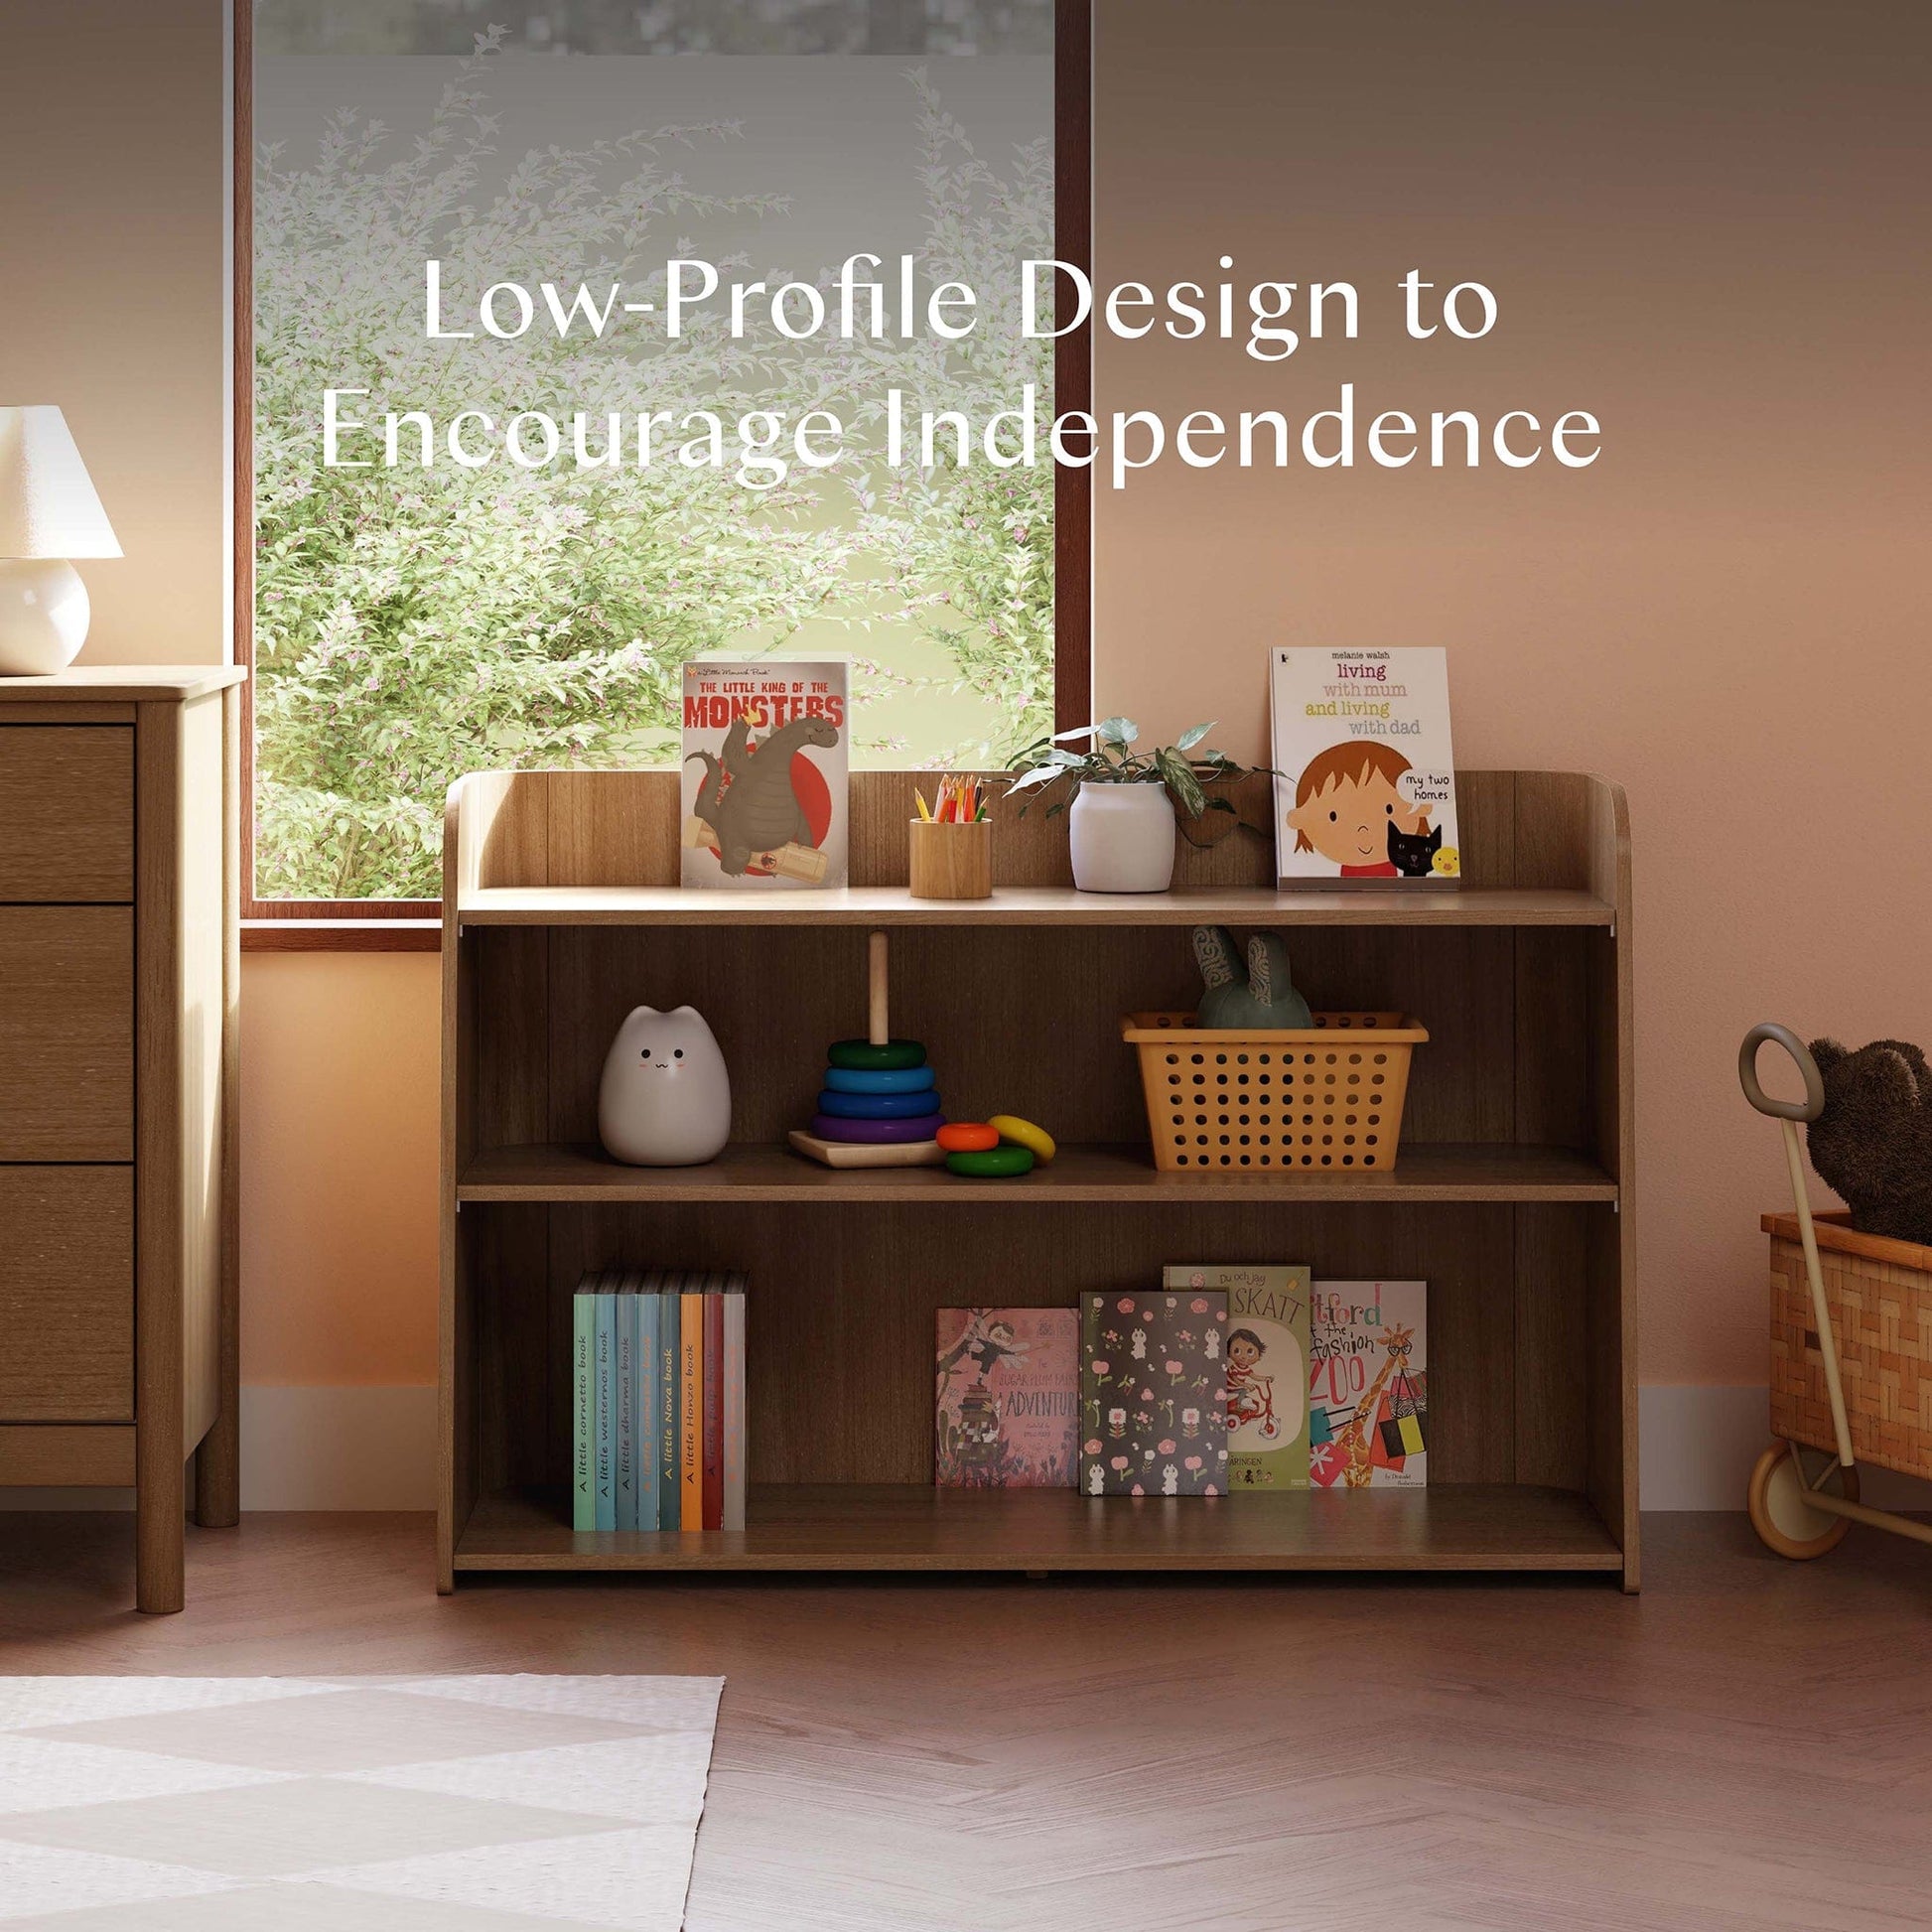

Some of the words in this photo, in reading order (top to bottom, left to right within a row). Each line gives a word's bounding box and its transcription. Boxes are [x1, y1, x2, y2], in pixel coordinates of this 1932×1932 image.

[1331, 651, 1364, 660] melanie
[1366, 651, 1390, 660] walsh
[1337, 663, 1387, 681] living
[700, 682, 717, 693] THE
[723, 682, 755, 693] LITTLE
[761, 682, 786, 693] KING
[792, 682, 804, 693] OF
[811, 682, 828, 693] THE
[1323, 682, 1360, 697] with
[1362, 685, 1408, 697] mum
[684, 695, 844, 729] MONSTERS
[1305, 701, 1337, 716] and
[1341, 700, 1390, 718] living
[1349, 720, 1388, 735] with
[1390, 720, 1421, 735] dad
[1406, 775, 1424, 789] my
[1428, 774, 1449, 785] two
[1414, 789, 1449, 801] homes
[1219, 1274, 1231, 1284] Du
[1234, 1271, 1249, 1281] och
[1234, 1287, 1305, 1324] SKATT
[1324, 1323, 1346, 1337] the
[578, 1335, 588, 1369] book
[600, 1330, 609, 1364] book
[621, 1337, 629, 1371] book
[1310, 1331, 1374, 1365] fashion
[1310, 1355, 1365, 1405] ZOO
[578, 1374, 588, 1437] cornetto
[600, 1369, 609, 1442] westernos
[621, 1378, 629, 1434] dharma
[1006, 1391, 1078, 1418] ADVENTUR
[578, 1442, 588, 1476] little
[600, 1447, 609, 1480] little
[621, 1440, 629, 1473] little
[664, 1468, 672, 1479] A
[686, 1472, 694, 1484] A
[578, 1480, 588, 1492] A
[600, 1486, 609, 1497] A
[621, 1479, 629, 1491] A
